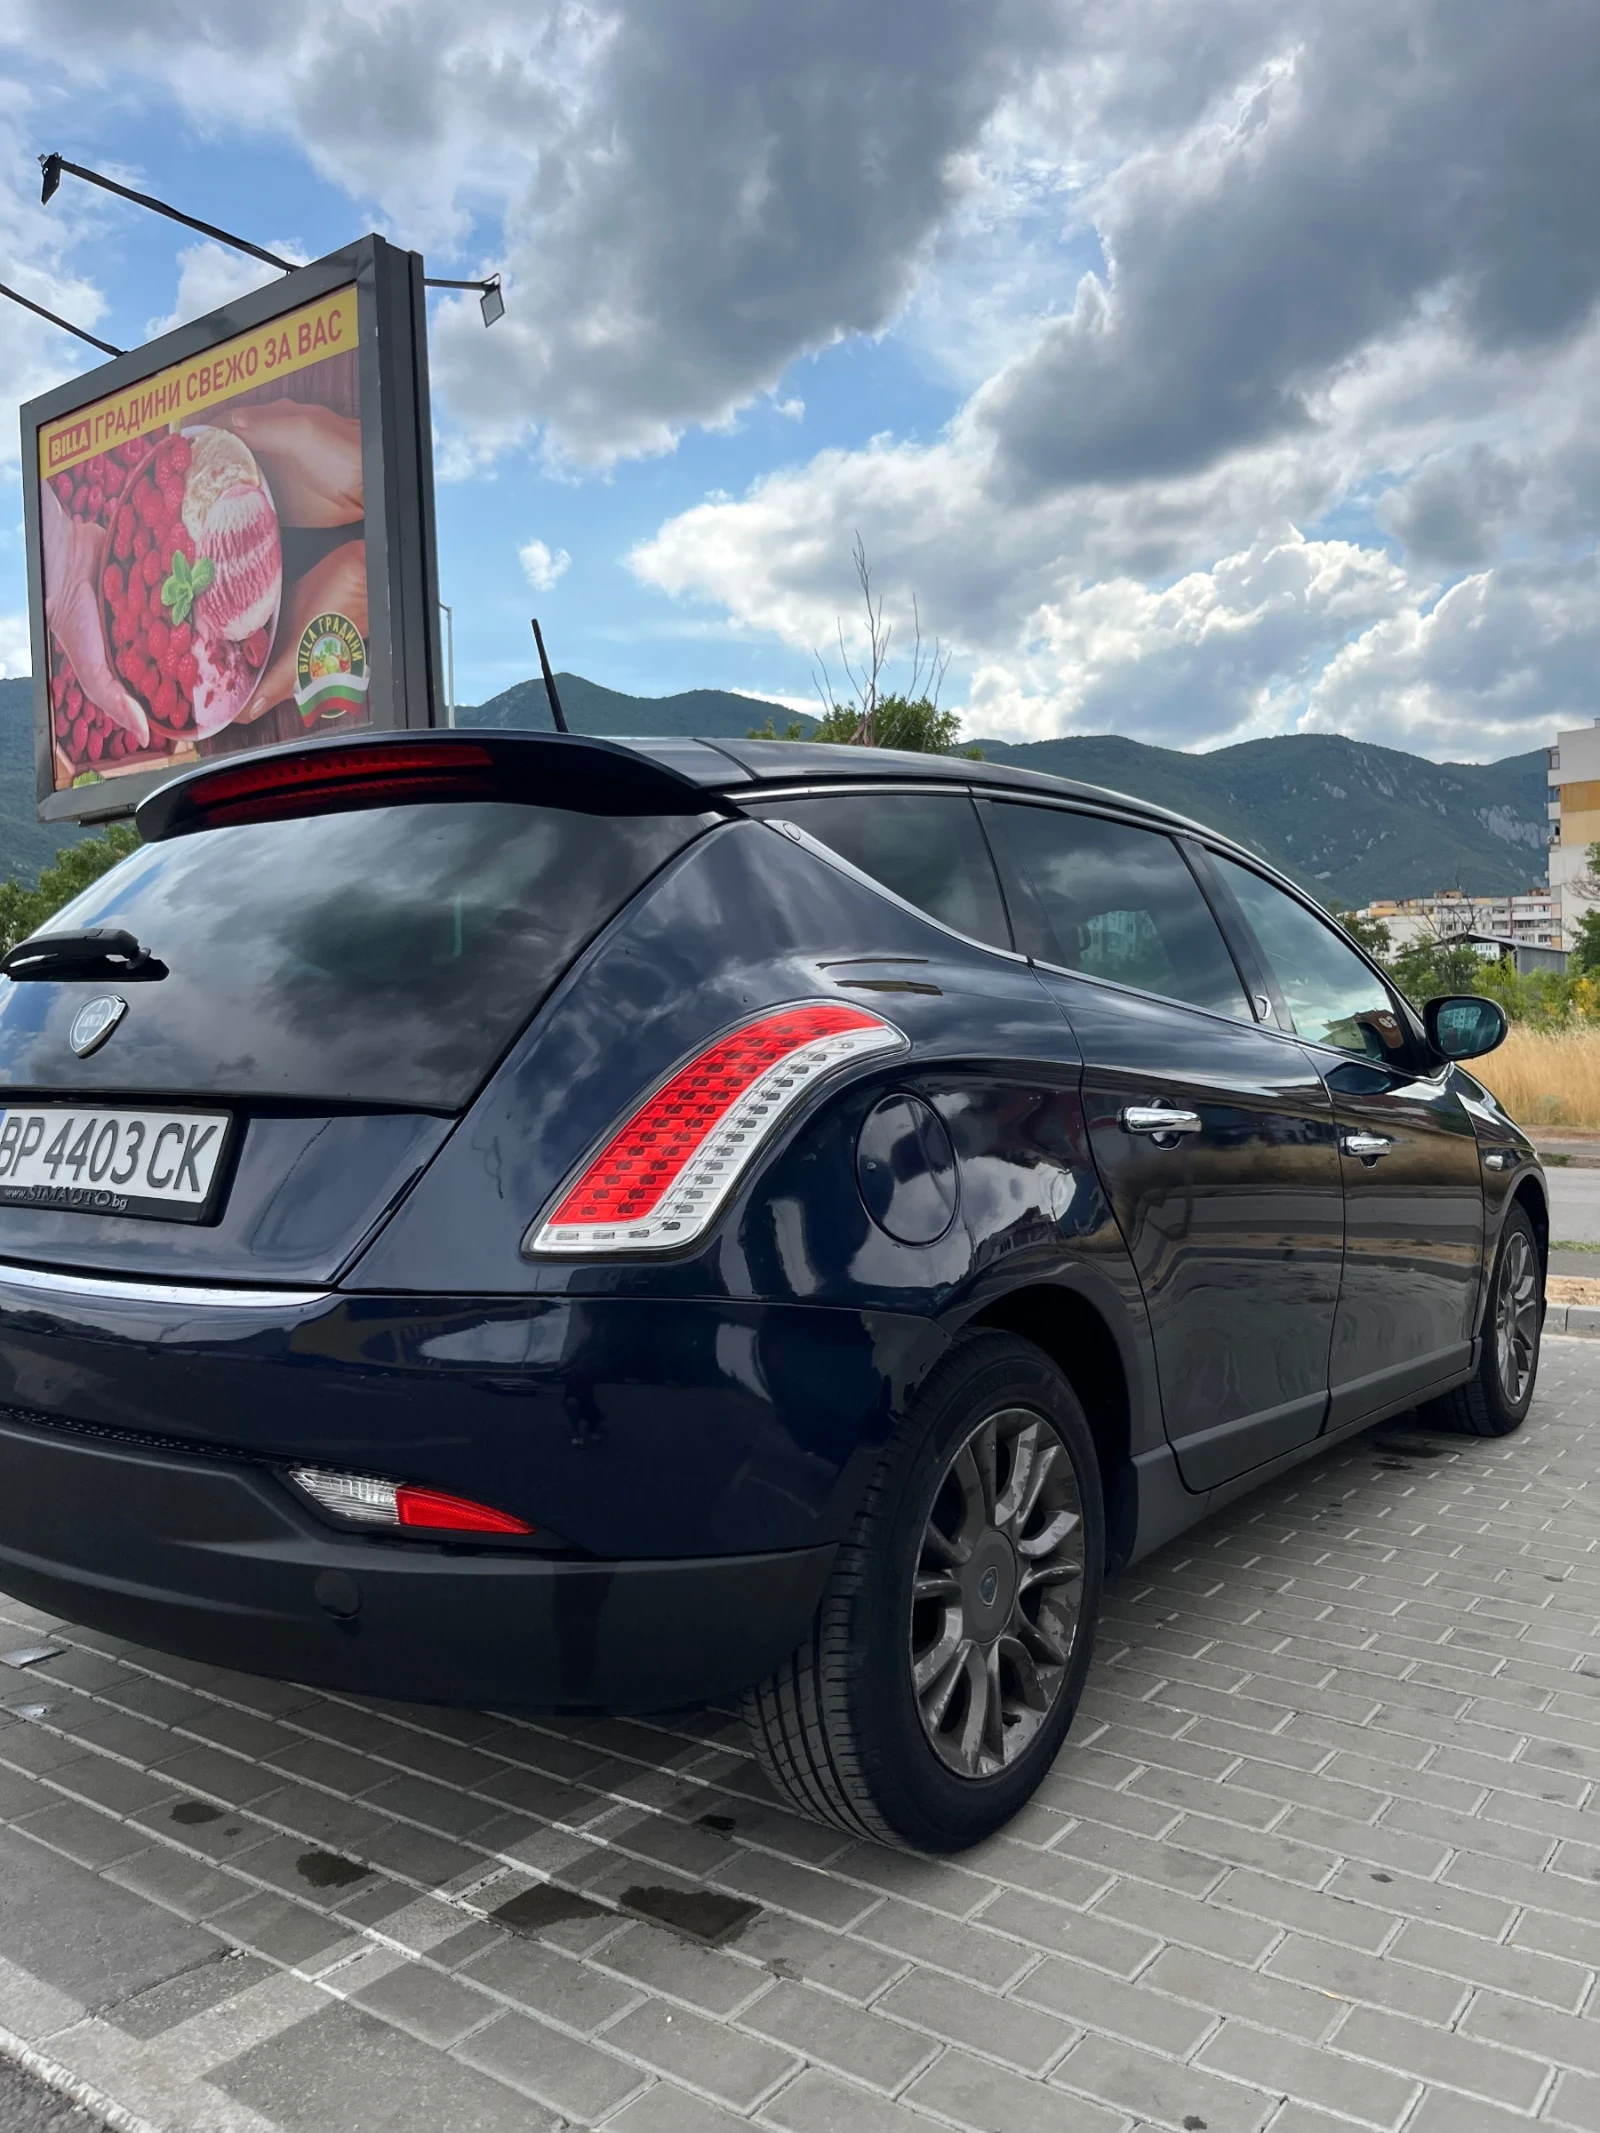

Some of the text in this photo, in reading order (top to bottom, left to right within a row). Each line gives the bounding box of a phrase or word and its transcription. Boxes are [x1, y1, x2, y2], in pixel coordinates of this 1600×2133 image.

[51, 309, 342, 460] BILLA ГРАДИНИ СВЕЖО ЗА ВАС
[299, 616, 363, 673] BILLA ГРАДИНИ
[43, 1117, 146, 1185] 4403
